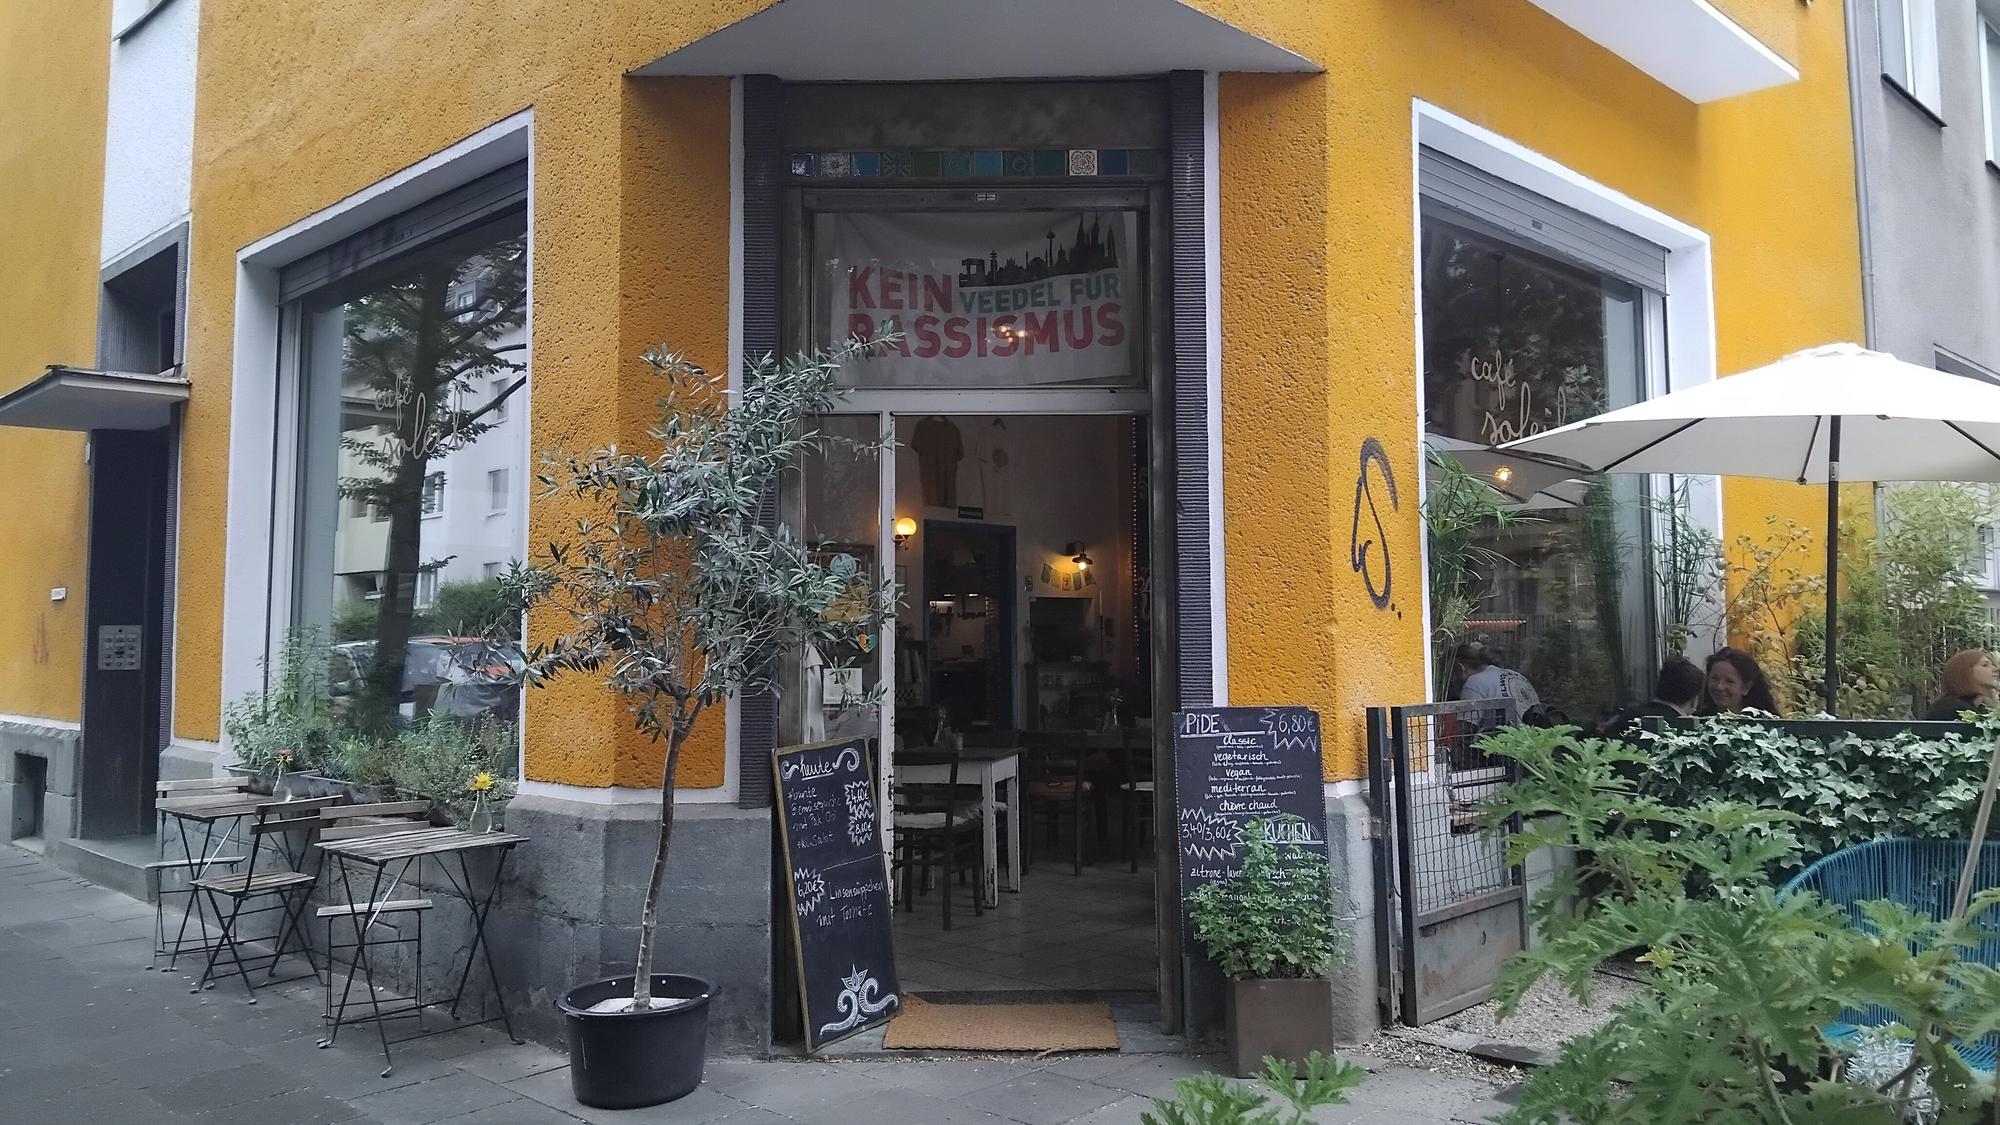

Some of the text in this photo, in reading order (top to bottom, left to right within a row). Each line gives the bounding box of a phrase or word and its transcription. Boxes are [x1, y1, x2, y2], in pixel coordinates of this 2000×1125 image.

[849, 266, 953, 314] KEIN
[959, 285, 1060, 314] VEEDEL
[849, 302, 1125, 358] RASSISMUS
[1471, 349, 1516, 411] café
[1278, 713, 1316, 734] 6,80€
[800, 754, 833, 776] heute
[1213, 750, 1269, 766] vegetarisch
[1211, 783, 1266, 793] mediterran
[1248, 798, 1277, 810] chaud
[1264, 822, 1311, 842] KUCHEN
[816, 906, 836, 927] mit
